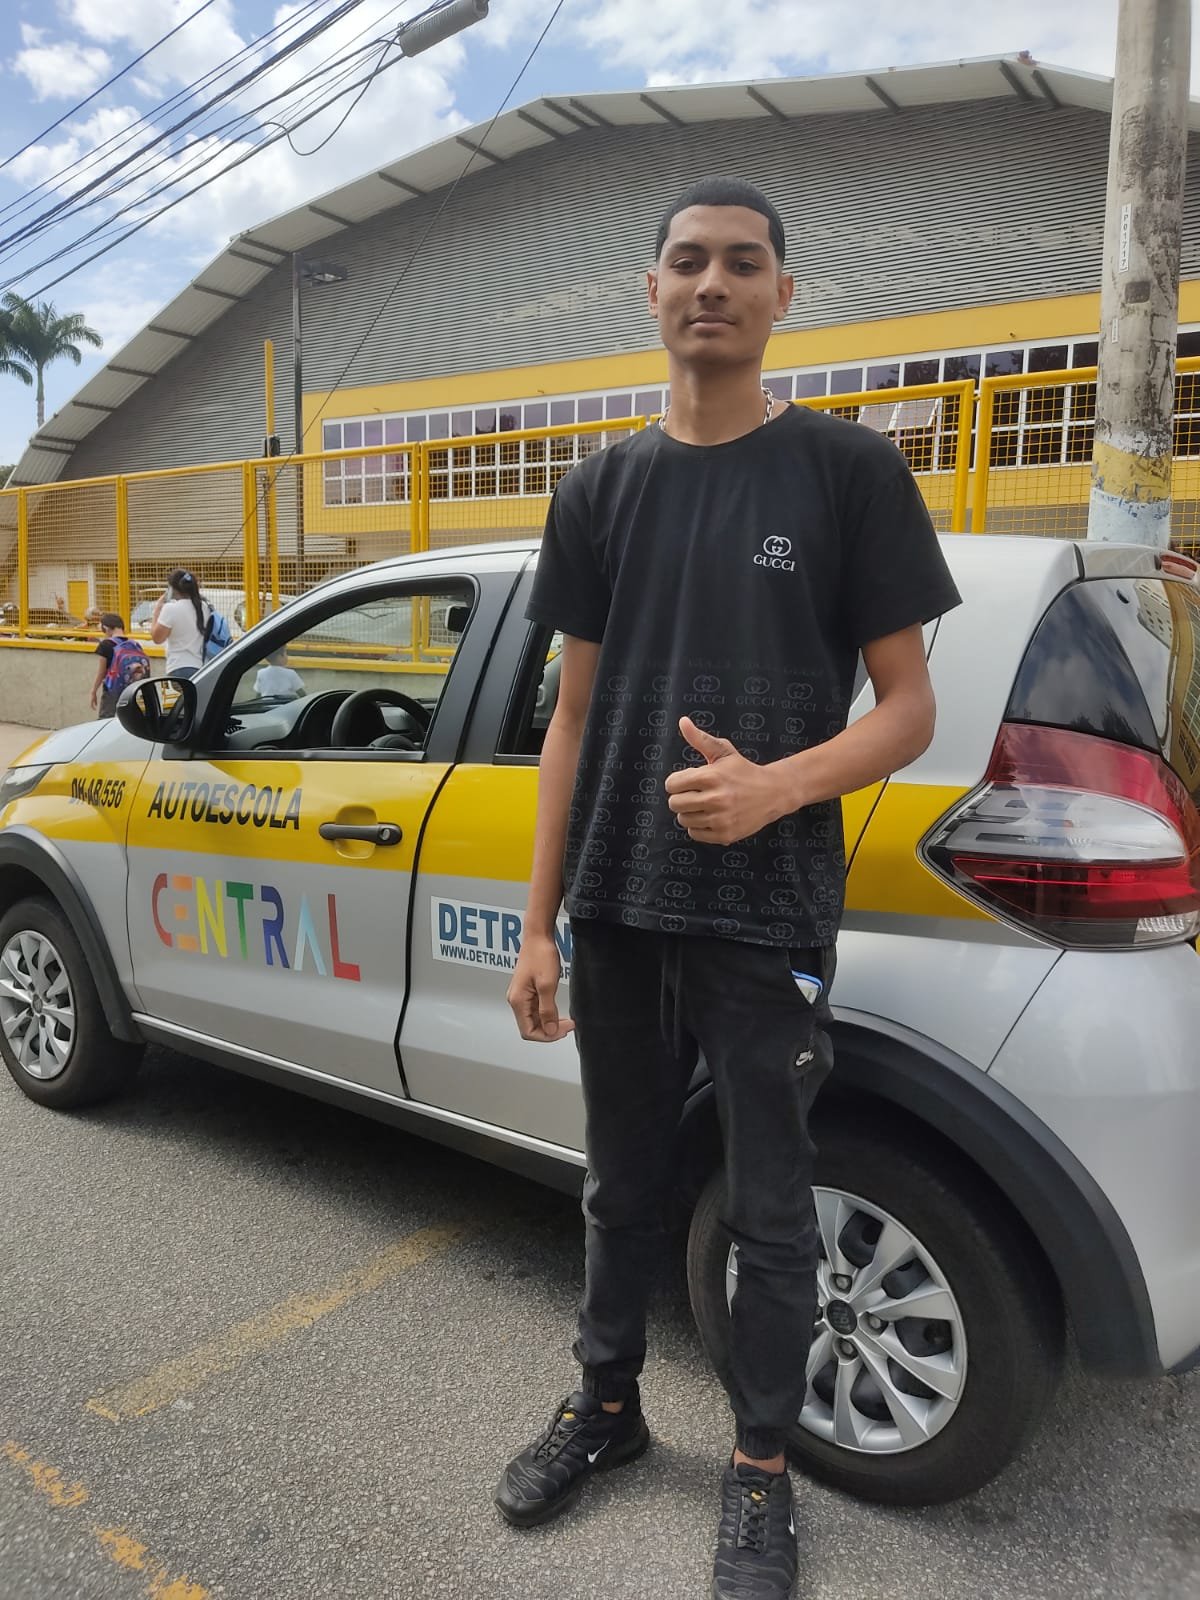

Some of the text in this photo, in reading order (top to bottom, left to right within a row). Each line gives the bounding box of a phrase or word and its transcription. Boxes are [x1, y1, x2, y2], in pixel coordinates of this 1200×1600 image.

[753, 554, 796, 572] GUCCI
[682, 694, 726, 704] GUCCI
[735, 695, 776, 706] GUCCI
[780, 699, 817, 712] GUCCI
[730, 730, 771, 742] GUCCI
[147, 782, 302, 830] AUTOESCOLA
[626, 826, 657, 839] GUCCI
[660, 864, 703, 876] GUCCI
[712, 868, 755, 880] GUCCI
[655, 897, 697, 910] GUCCI
[707, 901, 751, 913] GUCCI
[760, 906, 804, 916] GUCCI
[151, 872, 362, 983] CENTRAL
[438, 902, 572, 963] DETRN
